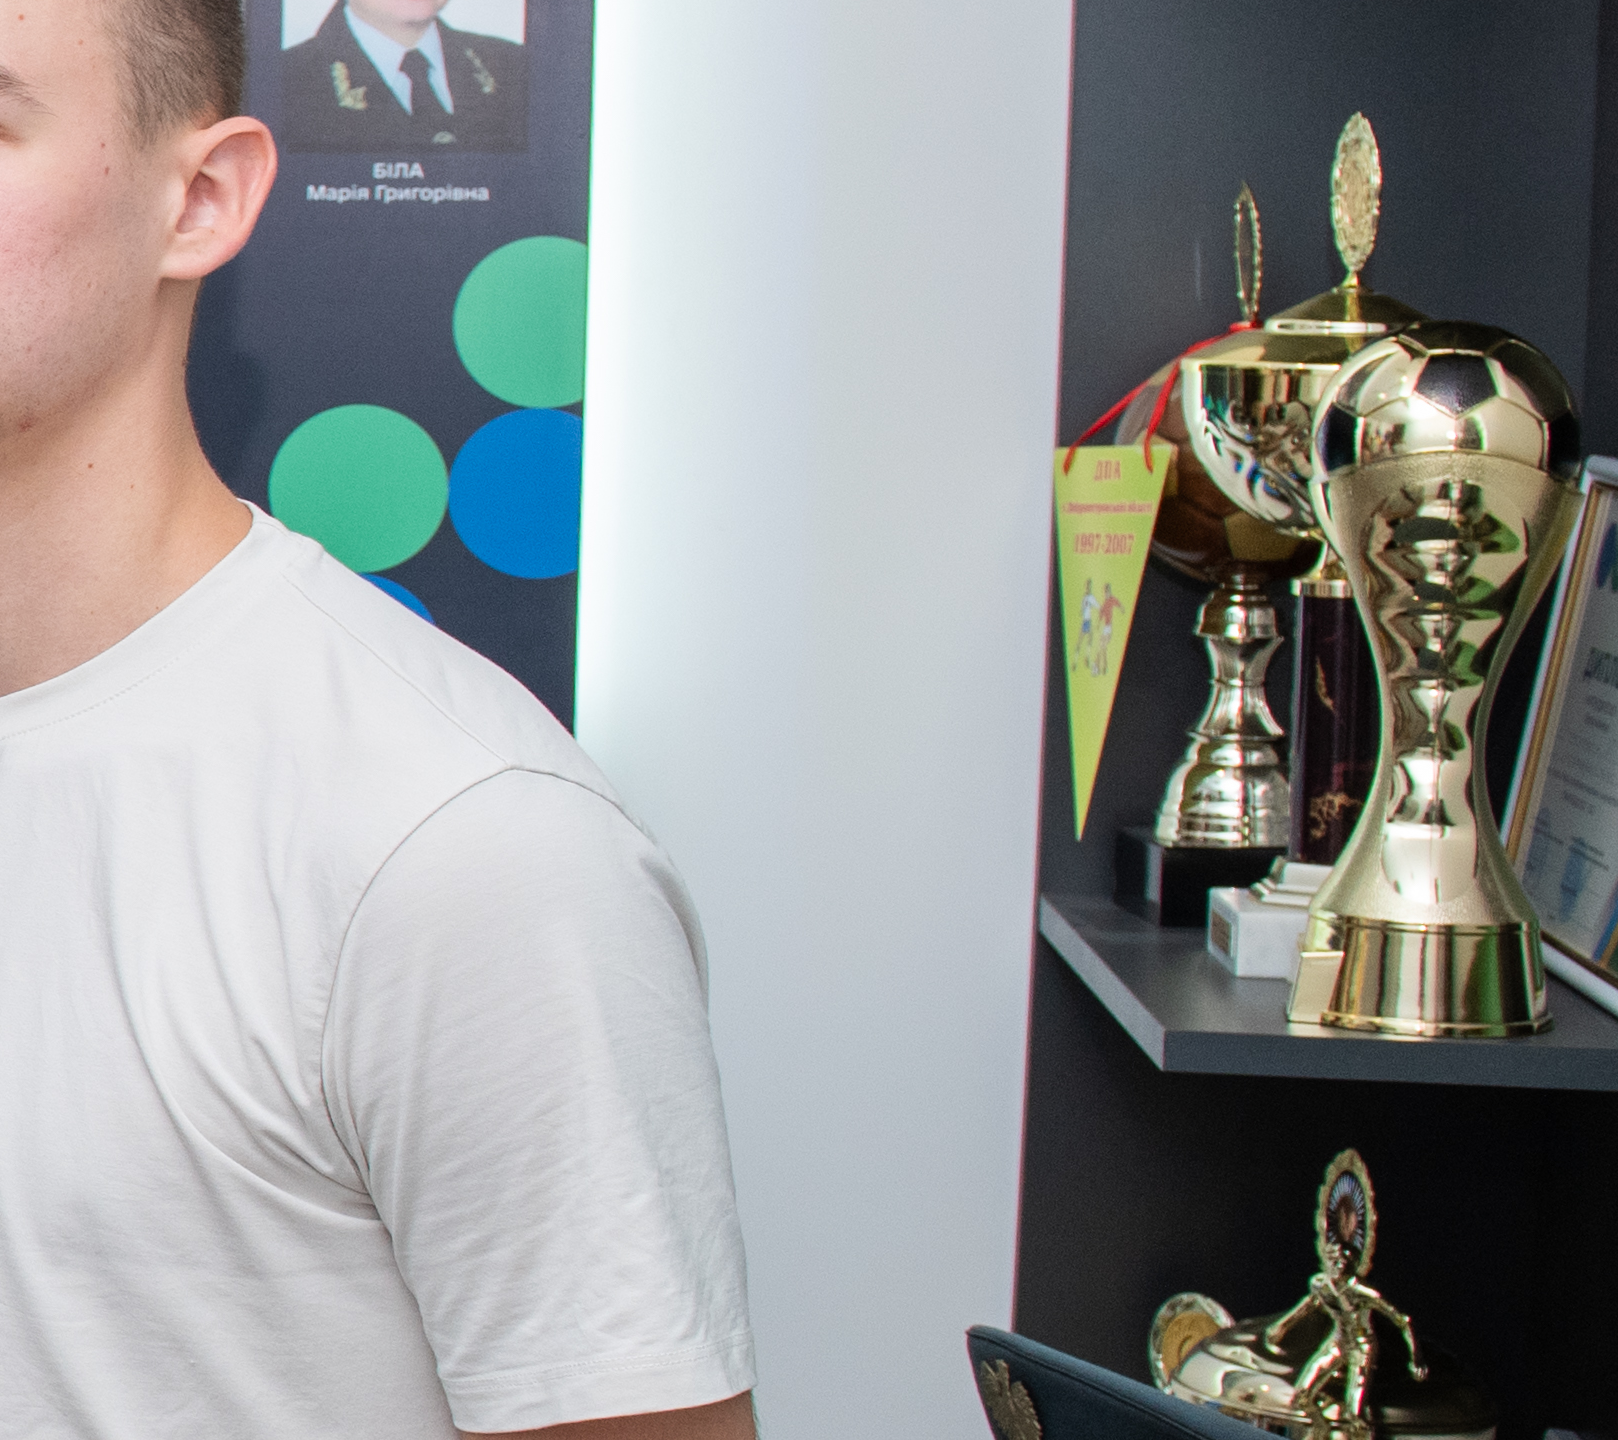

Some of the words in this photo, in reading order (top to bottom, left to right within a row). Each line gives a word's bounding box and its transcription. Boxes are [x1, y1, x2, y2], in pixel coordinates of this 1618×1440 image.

[373, 162, 424, 179] БІЛА
[307, 185, 370, 203] Марія
[375, 185, 489, 203] Григорівна
